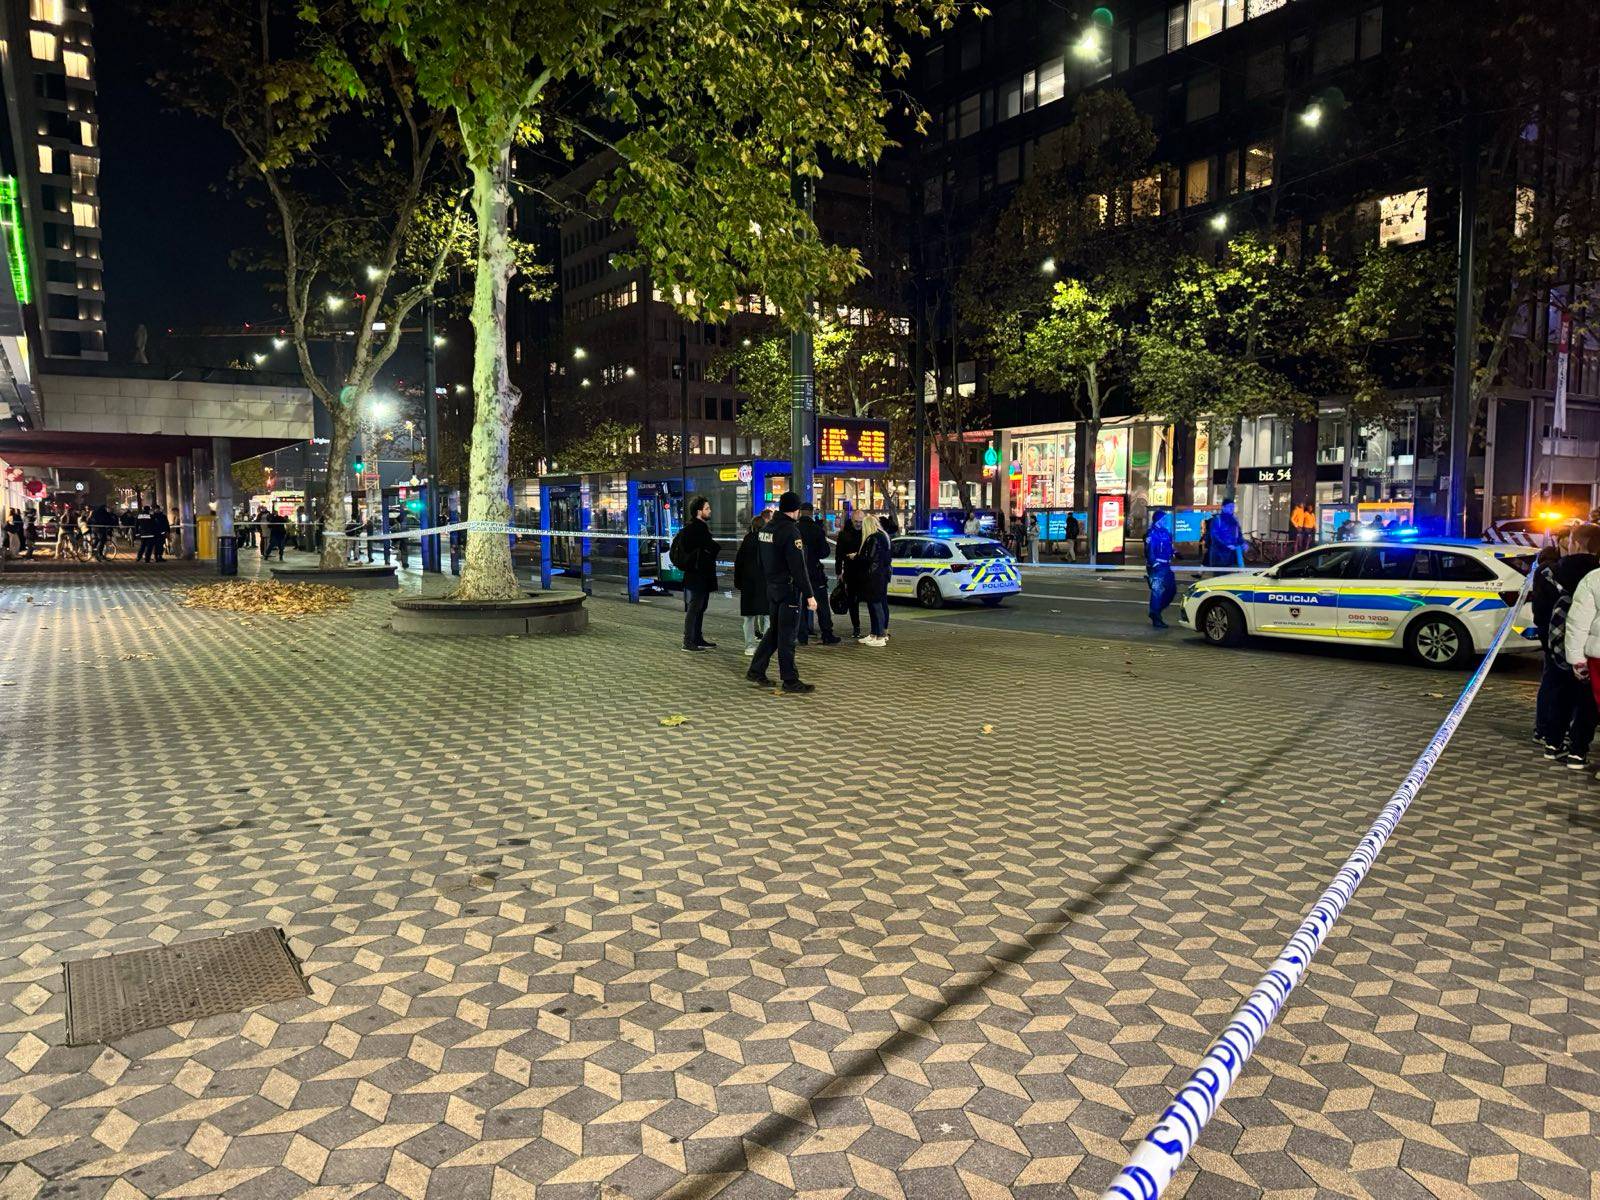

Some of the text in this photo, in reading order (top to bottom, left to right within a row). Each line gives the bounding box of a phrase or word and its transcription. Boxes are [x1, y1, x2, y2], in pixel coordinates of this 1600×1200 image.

[1258, 467, 1292, 481] biz 54
[982, 581, 1015, 589] POLICIJA
[1268, 593, 1319, 604] POLICIJA
[1145, 1067, 1220, 1177] STOP
